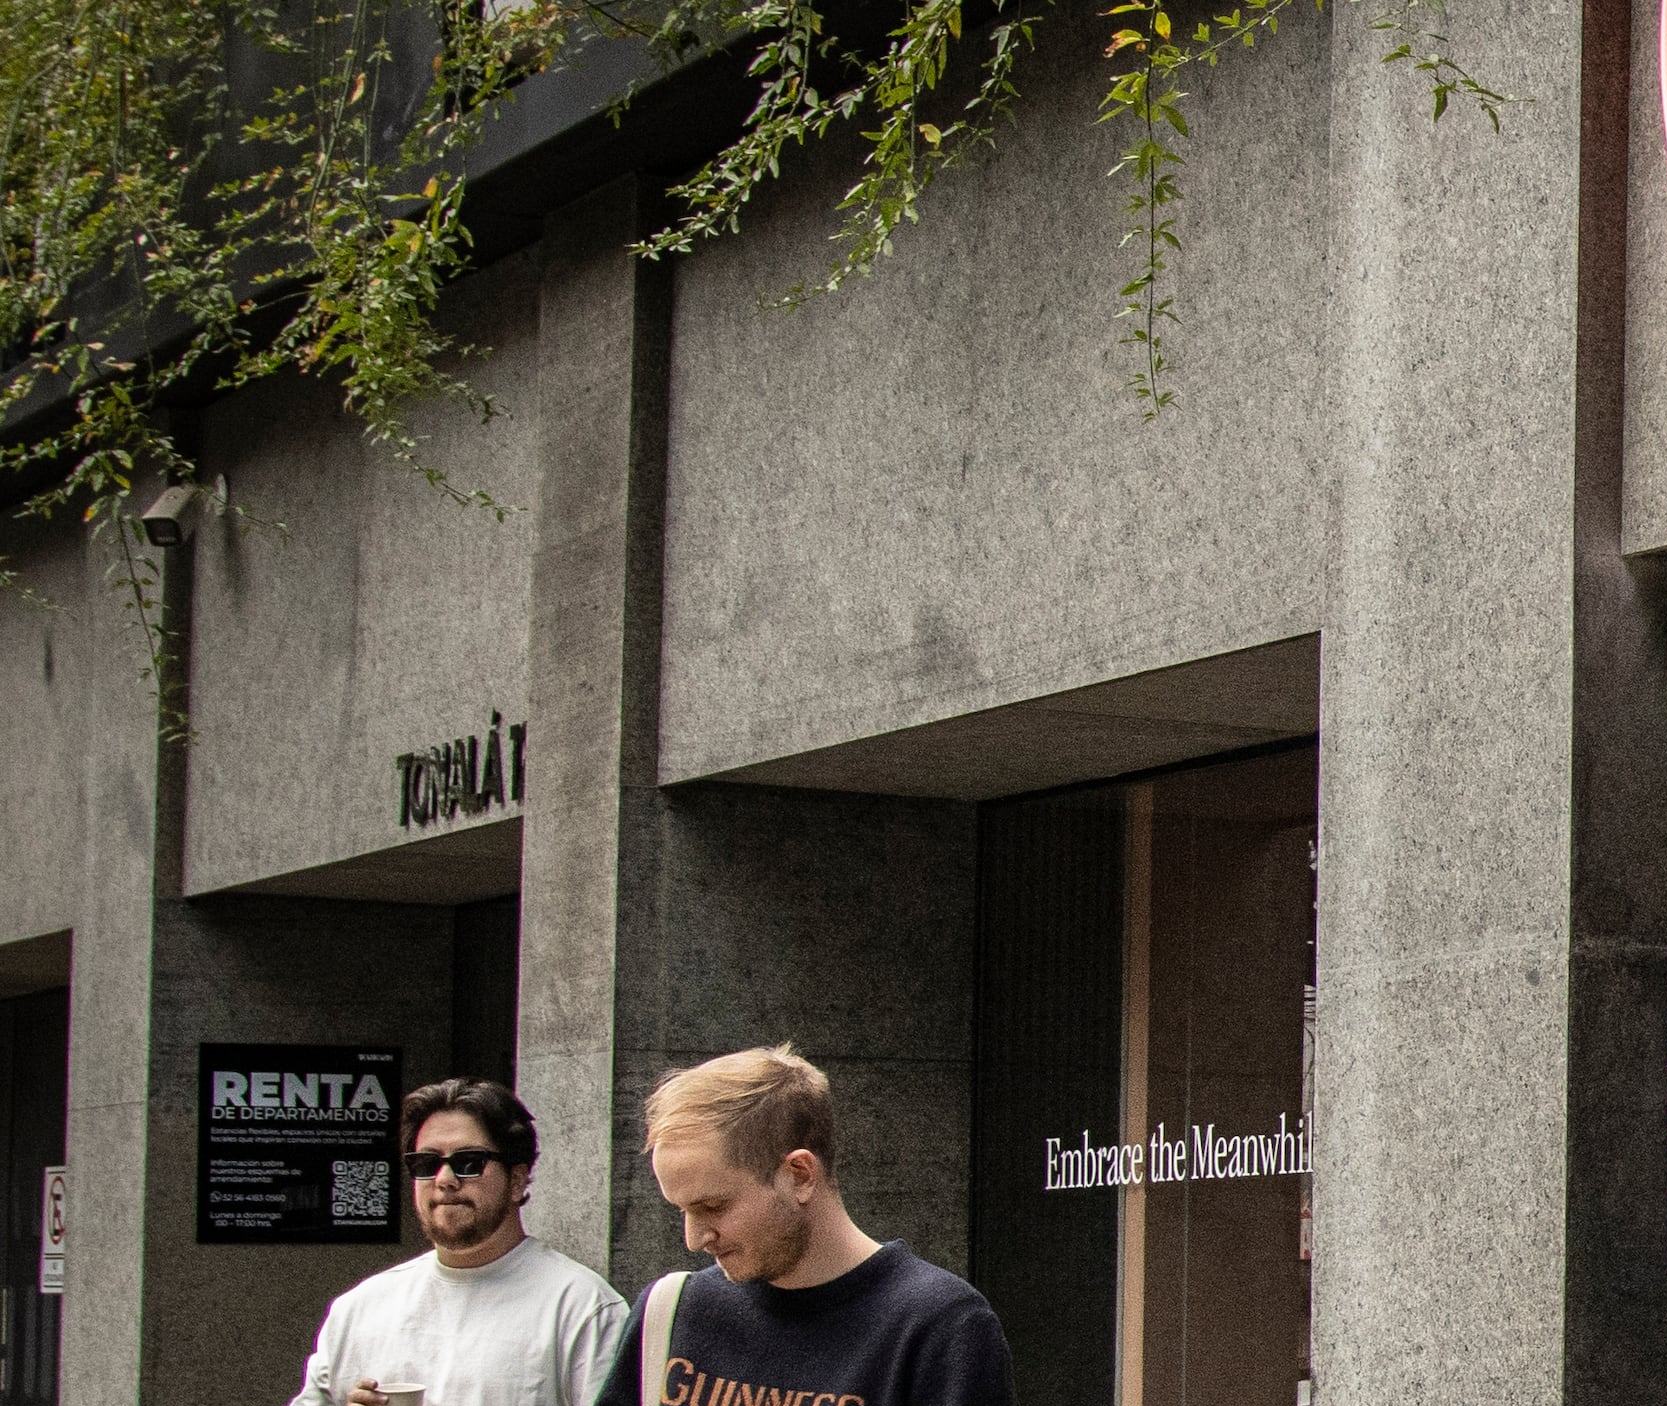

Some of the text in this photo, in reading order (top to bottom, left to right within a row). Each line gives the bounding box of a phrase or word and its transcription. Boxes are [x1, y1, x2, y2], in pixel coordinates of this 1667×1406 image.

[212, 1070, 391, 1110] RENTA
[212, 1107, 389, 1123] DE DEPARTAMENTOS
[1045, 1110, 1314, 1190] Embrace the Meanwhil
